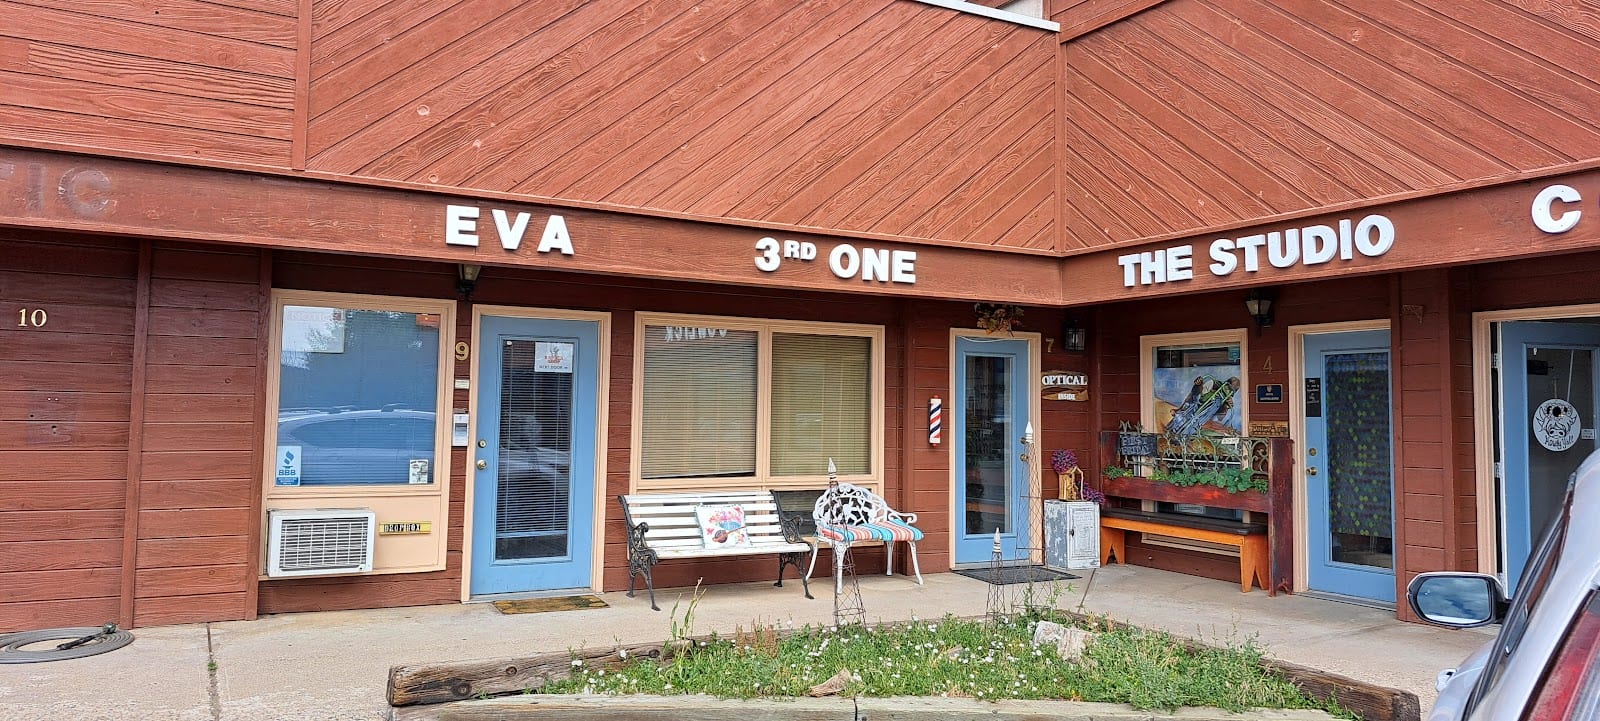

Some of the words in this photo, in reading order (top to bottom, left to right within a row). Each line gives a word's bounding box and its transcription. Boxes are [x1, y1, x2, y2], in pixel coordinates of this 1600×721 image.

[0, 163, 112, 217] IC
[445, 204, 575, 255] EVA
[754, 236, 817, 272] 3RD
[828, 243, 917, 284] ONE
[1118, 244, 1194, 287] THE
[1209, 214, 1395, 277] STUDIO
[17, 308, 47, 328] 10
[455, 341, 470, 361] 9
[1045, 337, 1055, 353] 7
[1262, 355, 1273, 375] 4
[1041, 375, 1088, 386] OPTICAL
